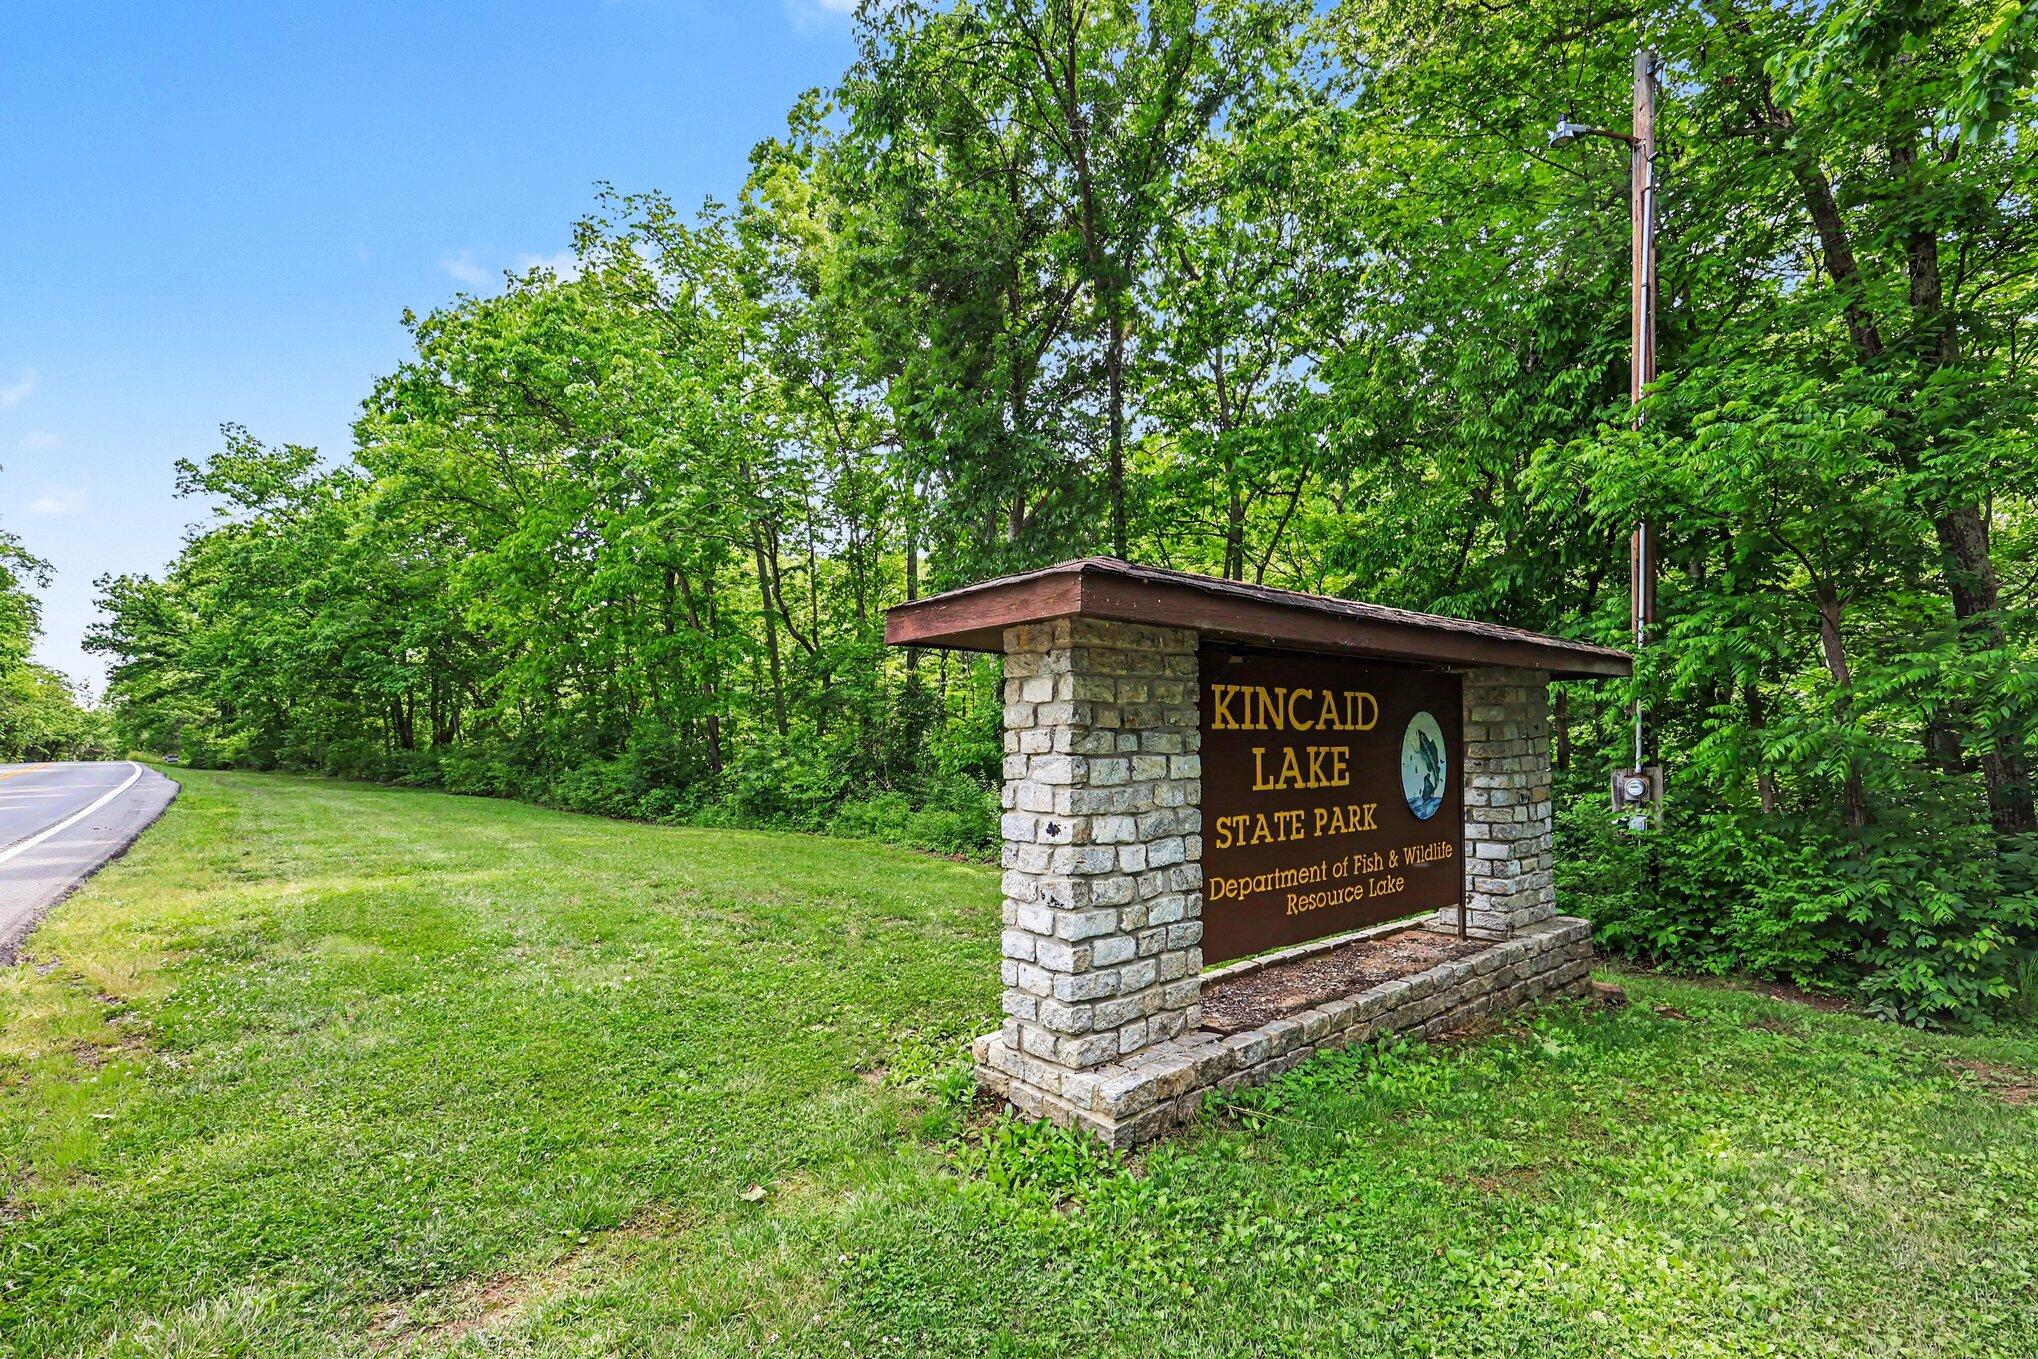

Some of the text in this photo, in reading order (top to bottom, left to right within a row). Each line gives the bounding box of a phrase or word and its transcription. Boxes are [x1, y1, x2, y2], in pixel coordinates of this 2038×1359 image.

[1211, 684, 1379, 731] KINCAID
[1252, 746, 1350, 791] LAKE
[1216, 803, 1378, 849] STATE PARK
[1209, 841, 1453, 901] Department of Fish & Wildlife
[1286, 875, 1404, 915] Resource Lake
